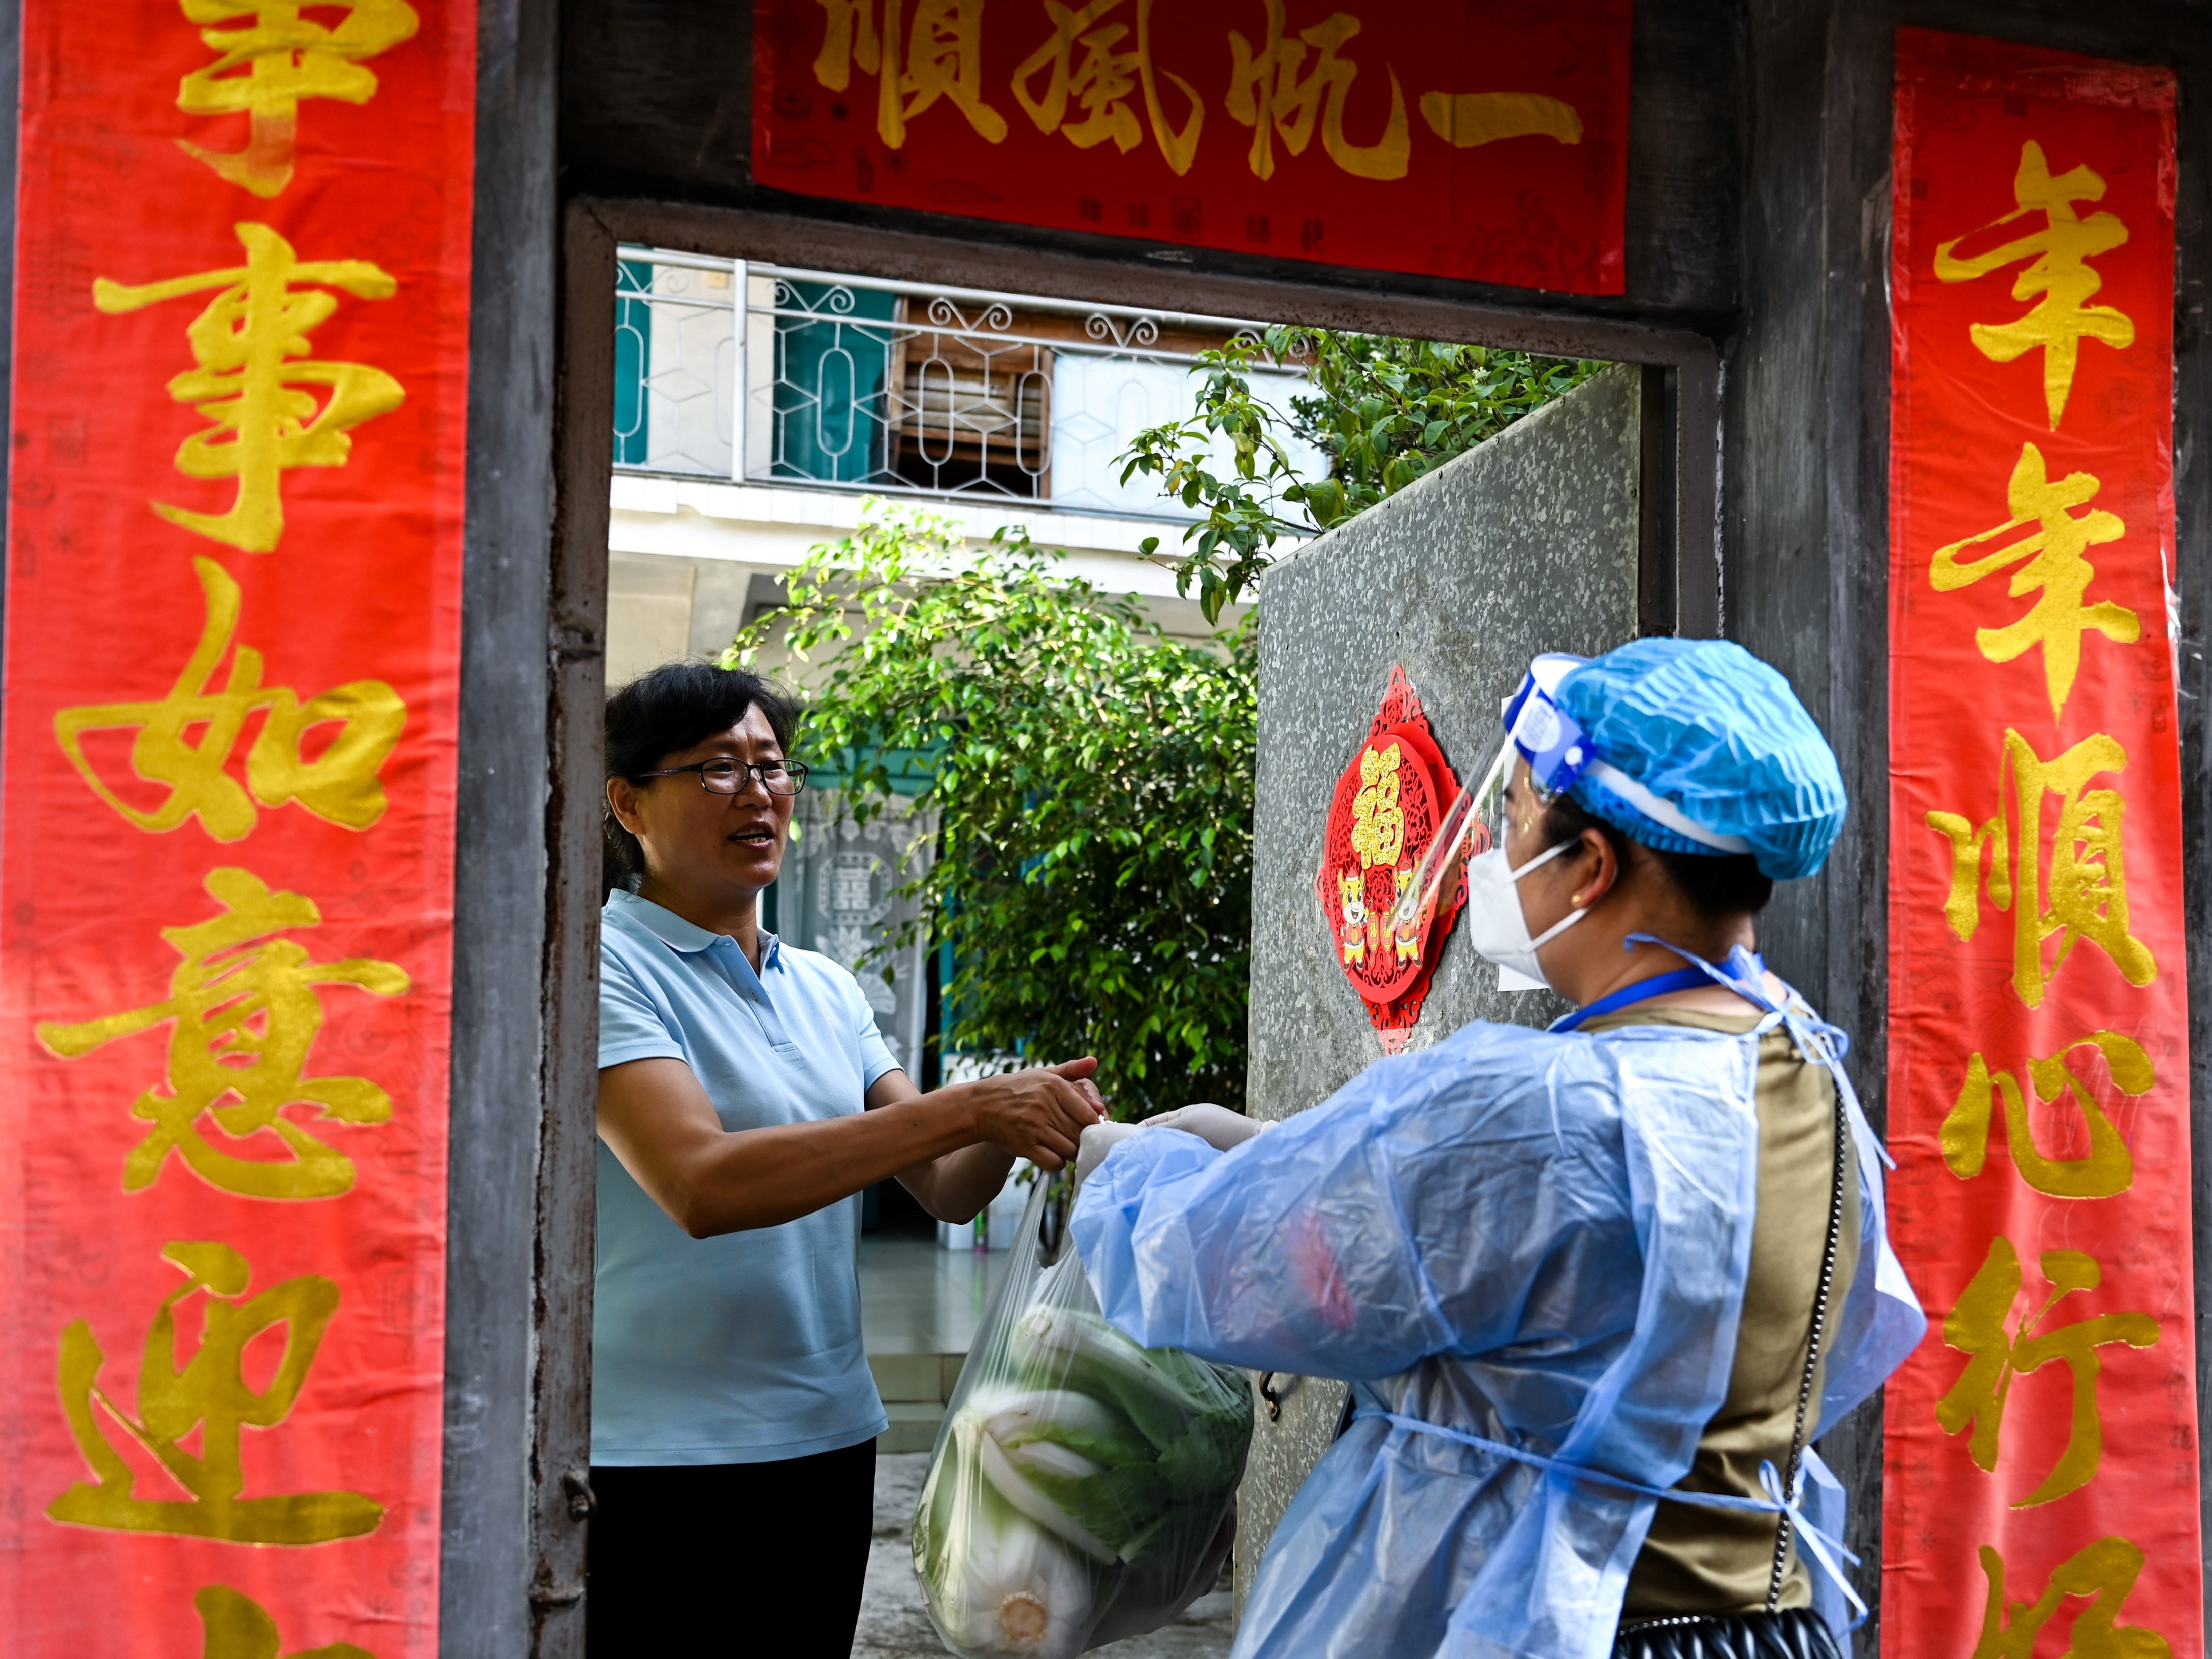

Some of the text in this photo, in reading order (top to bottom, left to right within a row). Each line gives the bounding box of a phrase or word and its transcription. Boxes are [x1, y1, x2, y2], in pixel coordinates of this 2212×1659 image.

[35, 0, 417, 1659] 事事如意迎
[1351, 741, 1406, 870] 福
